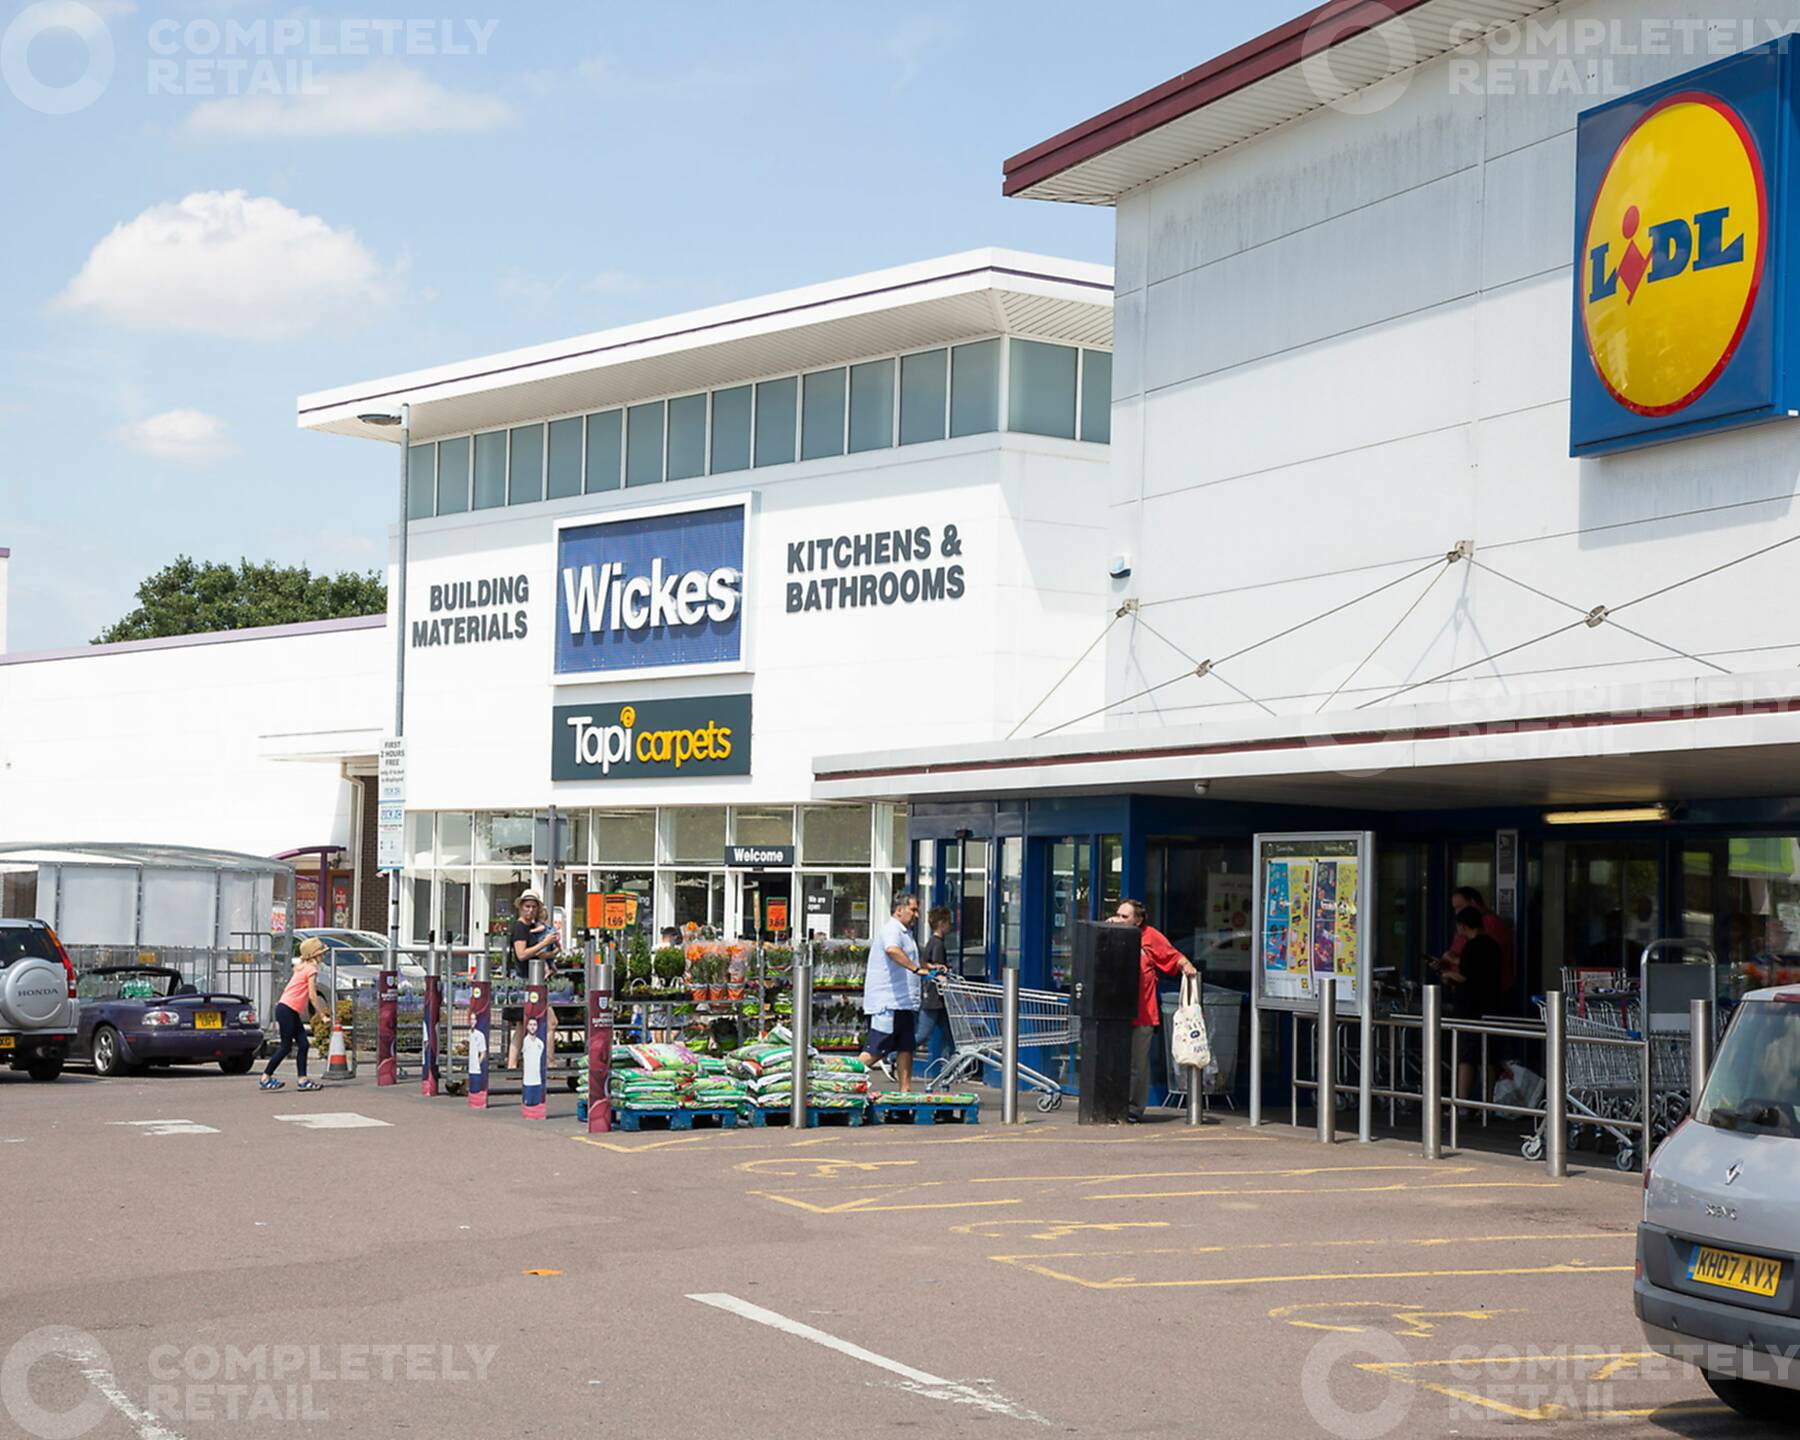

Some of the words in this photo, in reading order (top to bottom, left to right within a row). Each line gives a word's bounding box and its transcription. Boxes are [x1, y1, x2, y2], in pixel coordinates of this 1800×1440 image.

[787, 526, 931, 574] KITCHENS
[940, 524, 963, 558] &
[430, 574, 529, 613] BUILDING
[563, 557, 741, 634] Wickes
[786, 565, 966, 613] BATHROOMS
[412, 609, 528, 648] MATERIALS
[385, 749, 405, 757] HOURS
[567, 706, 636, 774] Tapi
[635, 720, 732, 768] carpets
[734, 848, 784, 862] Welcome
[18, 987, 59, 997] HONDA
[1697, 1250, 1740, 1281] KH07
[1740, 1259, 1779, 1290] AVX
